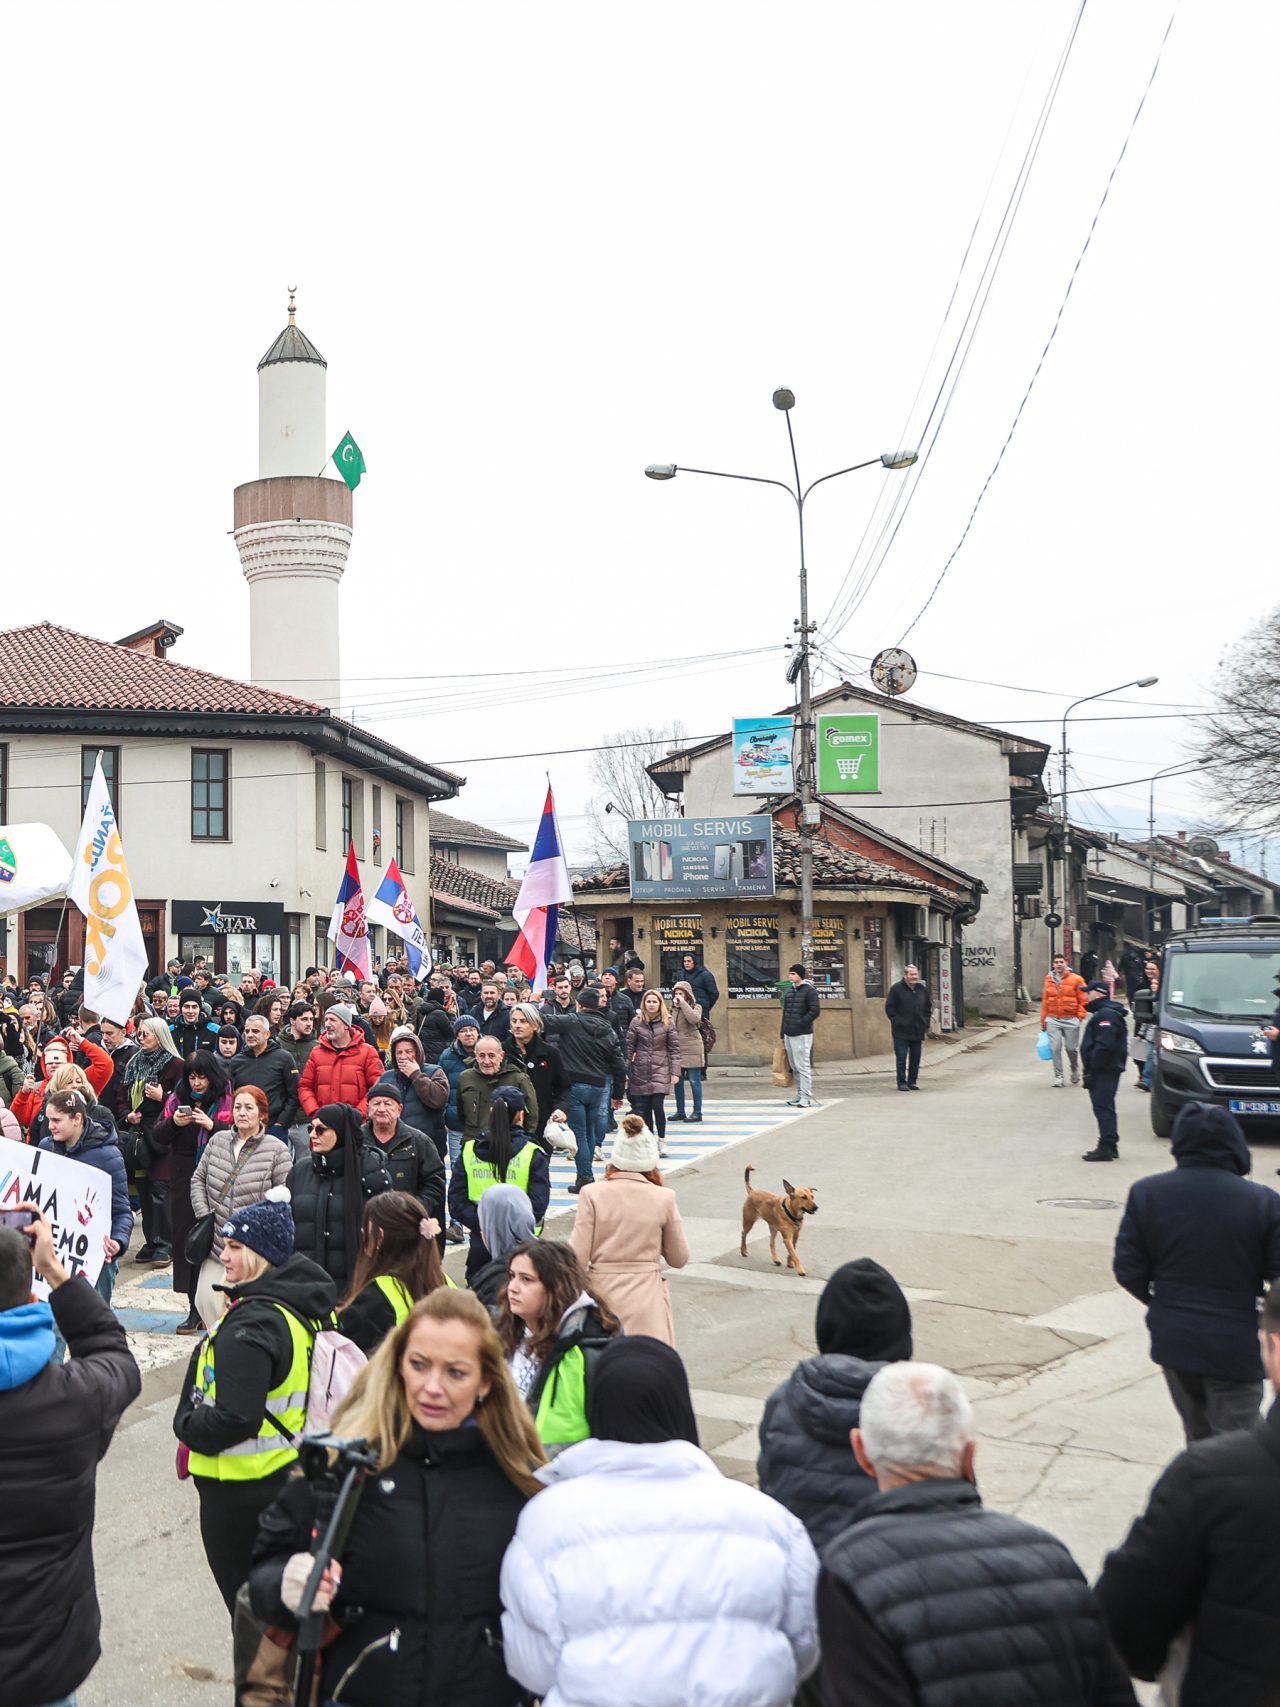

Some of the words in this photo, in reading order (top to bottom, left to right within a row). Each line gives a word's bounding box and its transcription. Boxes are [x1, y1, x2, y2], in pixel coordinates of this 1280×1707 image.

[832, 735, 867, 745] gomex
[642, 823, 687, 837] MOBIL
[693, 821, 753, 836] SERVIS
[683, 872, 709, 880] iPhone
[738, 884, 766, 892] ZAMENA
[215, 917, 257, 930] STAR
[664, 930, 694, 938] NOKIA
[737, 929, 770, 937] NOKIA
[961, 946, 996, 956] INOVI
[962, 957, 996, 967] OSNE
[942, 969, 950, 1026] BUREK
[31, 1150, 41, 1175] I
